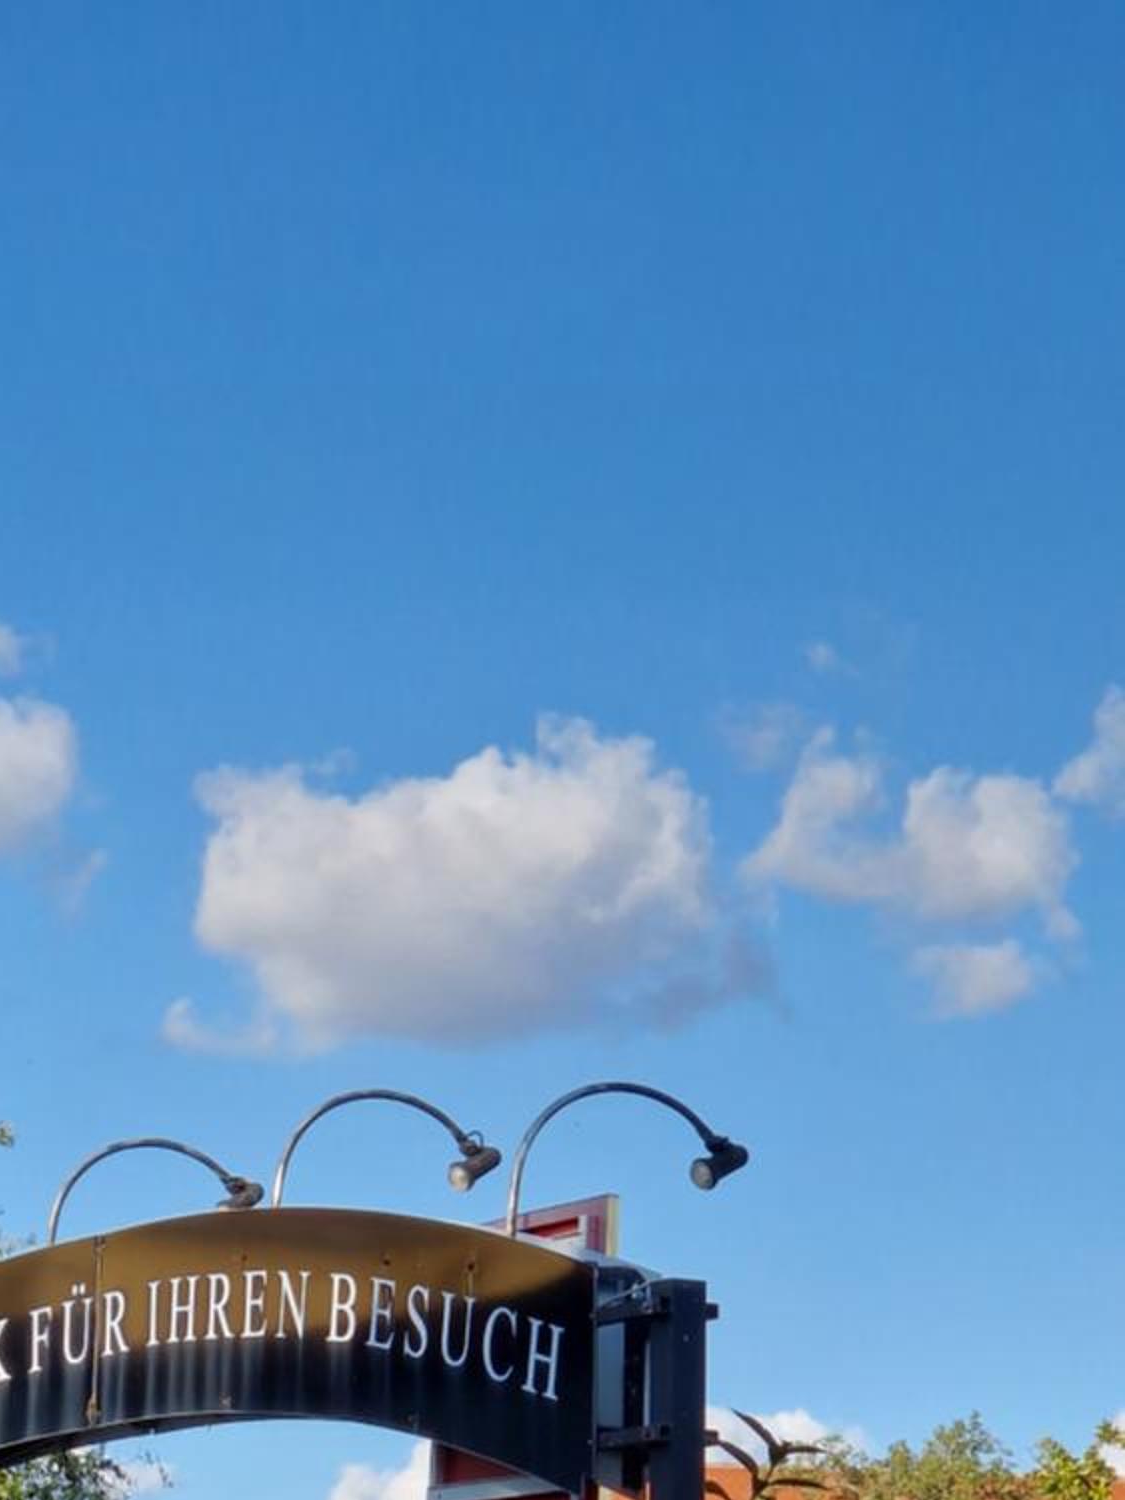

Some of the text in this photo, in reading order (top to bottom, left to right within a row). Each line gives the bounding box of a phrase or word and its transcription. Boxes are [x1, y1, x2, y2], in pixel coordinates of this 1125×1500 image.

[27, 1283, 130, 1375] FÜR
[145, 1269, 312, 1347] IHREN
[325, 1271, 566, 1402] BESUCH
